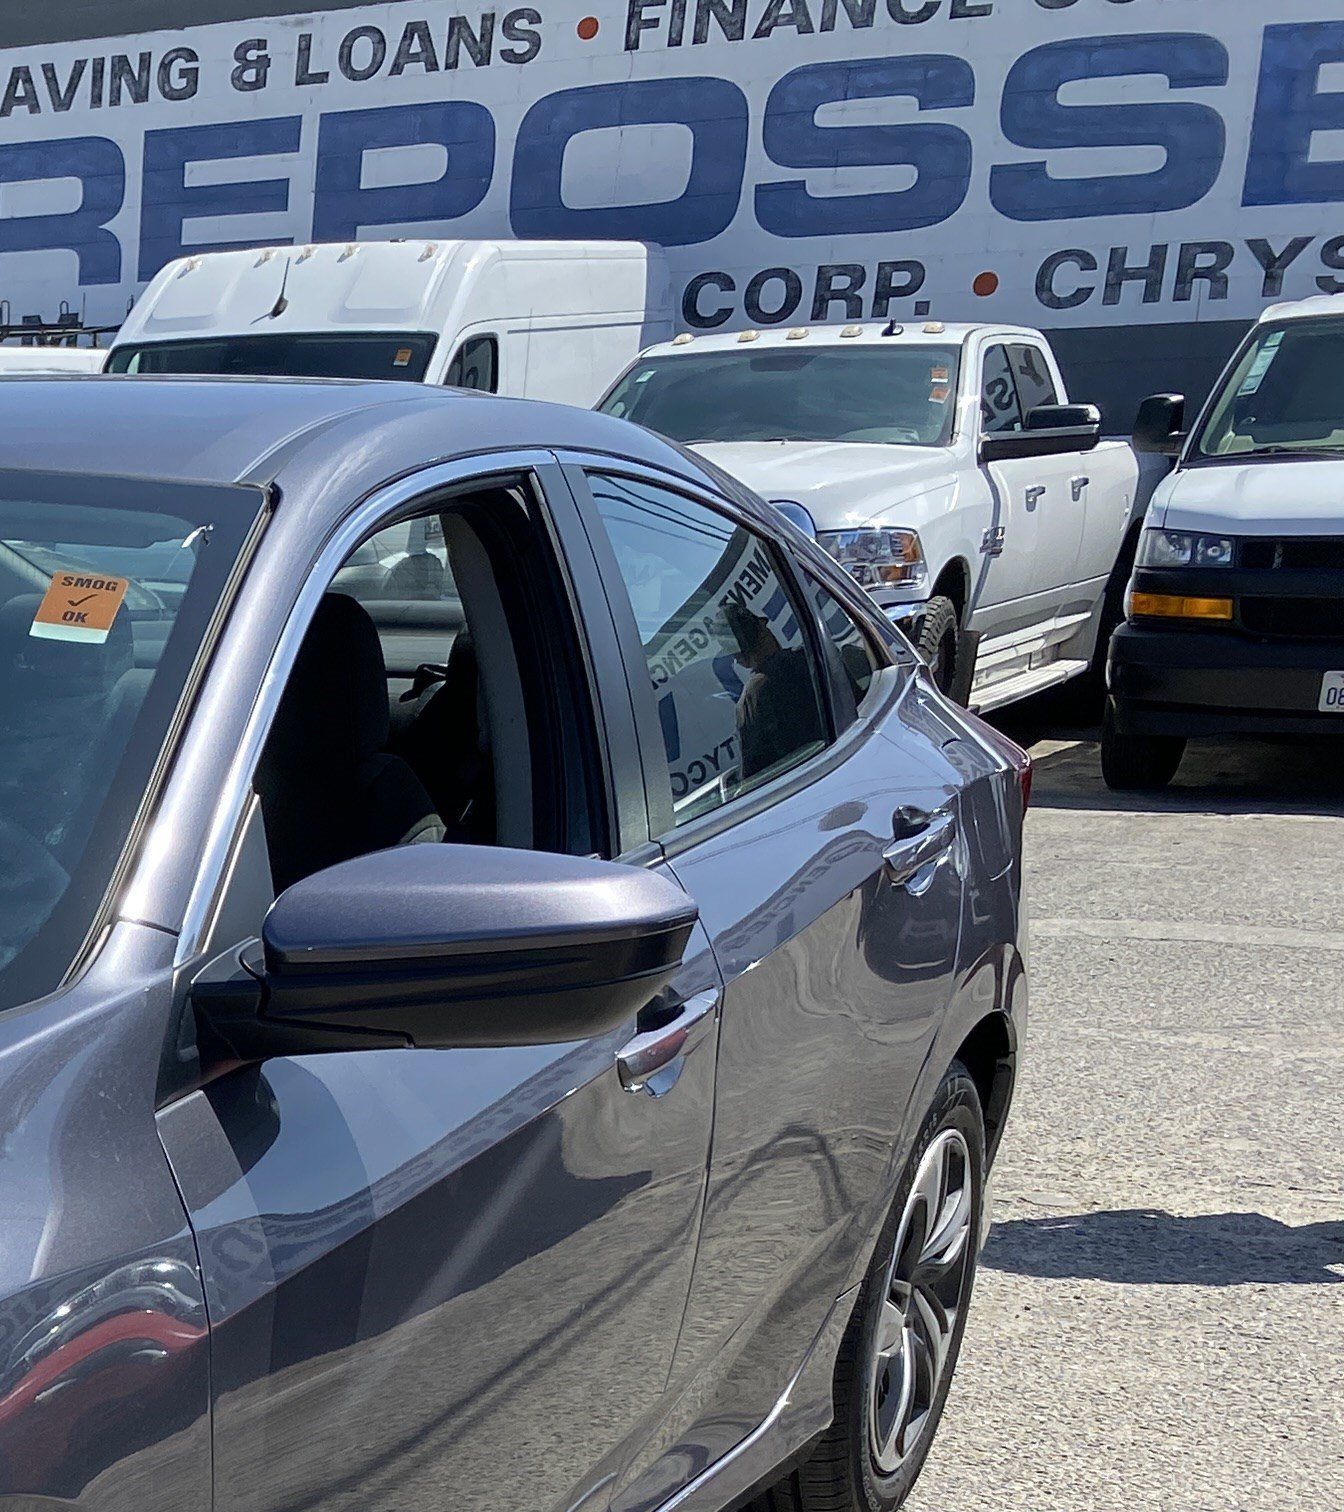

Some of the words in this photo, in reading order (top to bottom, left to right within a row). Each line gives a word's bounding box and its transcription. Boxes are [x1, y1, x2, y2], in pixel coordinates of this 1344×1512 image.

[231, 38, 271, 92] &
[295, 6, 543, 86] LOANS
[682, 259, 930, 328] CORP.
[61, 576, 118, 592] SMOG
[62, 610, 90, 624] OK
